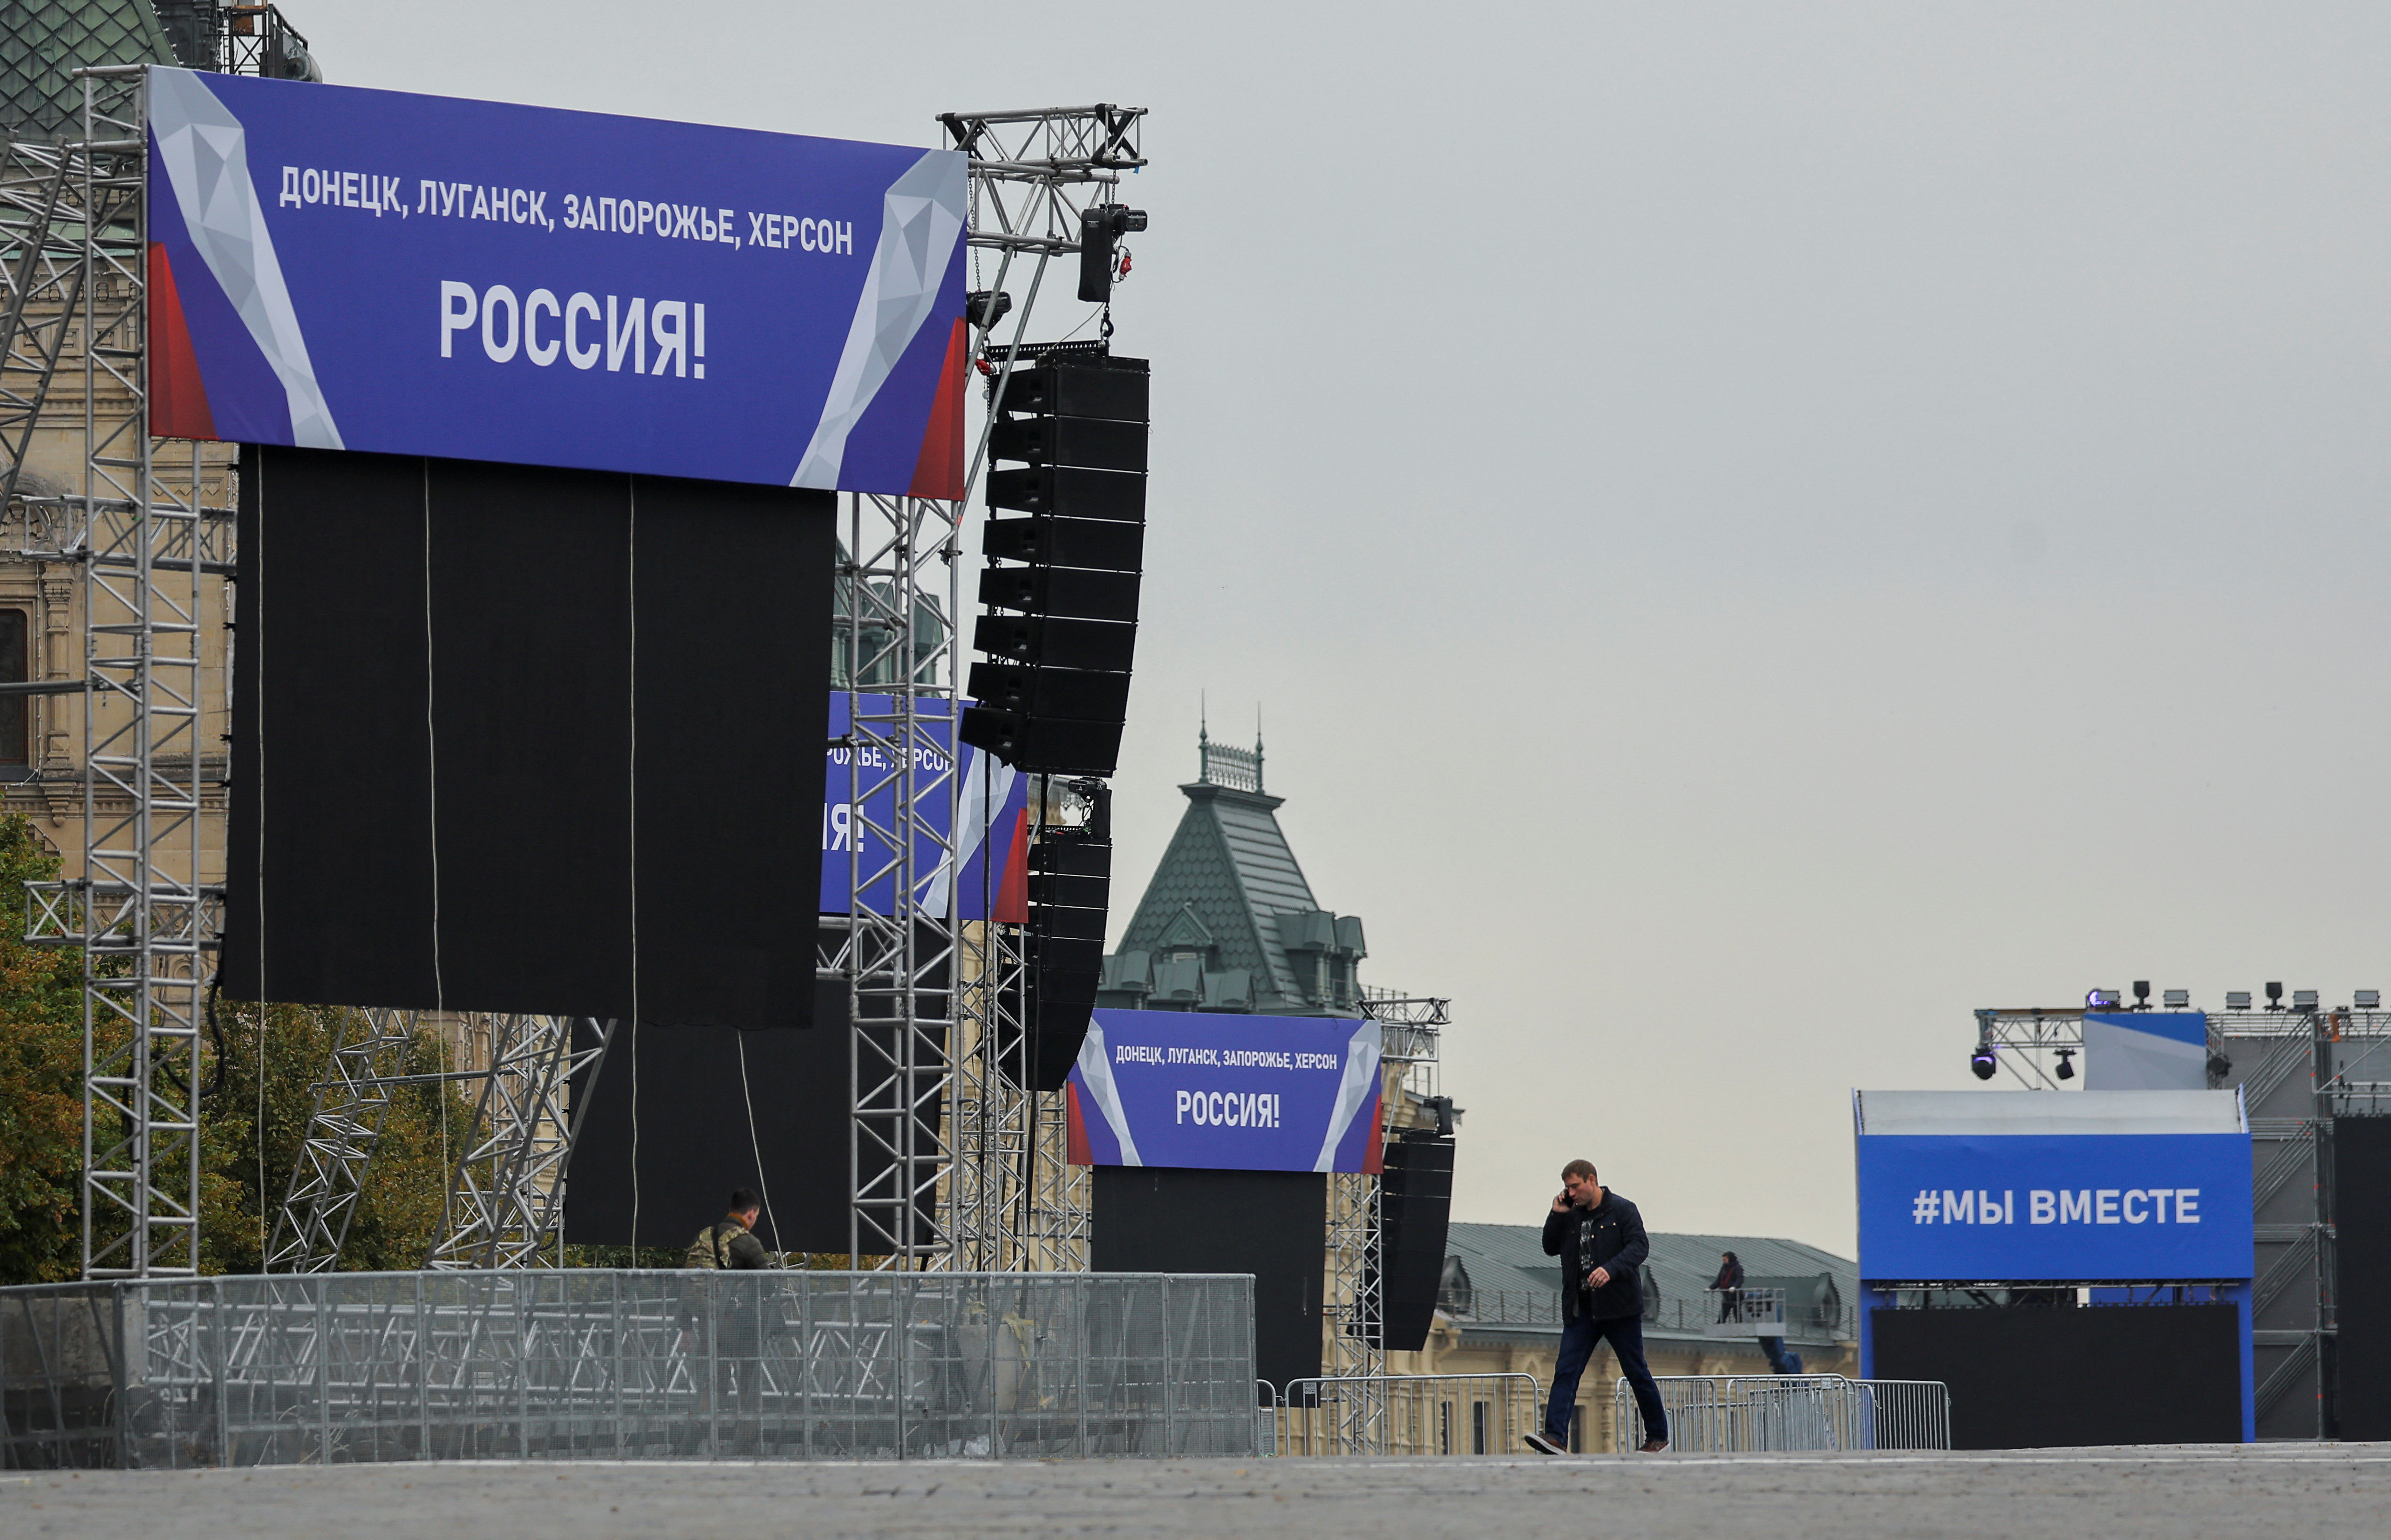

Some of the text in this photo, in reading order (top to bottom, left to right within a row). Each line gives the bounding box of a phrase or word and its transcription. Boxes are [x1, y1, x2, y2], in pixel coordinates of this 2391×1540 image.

[279, 166, 852, 255] ДОНЕЦК, ЛУГАНСК, ЗАПОРОЖЬЕ, ХЕРСОН
[441, 280, 705, 380] РОССИЯ!
[1116, 1045, 1337, 1071] ДОНЕЦК, ЛУГАНСК, ЗАПОРОЖЬЕ, ХЕРСОН
[1177, 1090, 1279, 1128] РОССИЯ!
[1913, 1189, 2200, 1224] #МЫ ВМЕСТЕ
